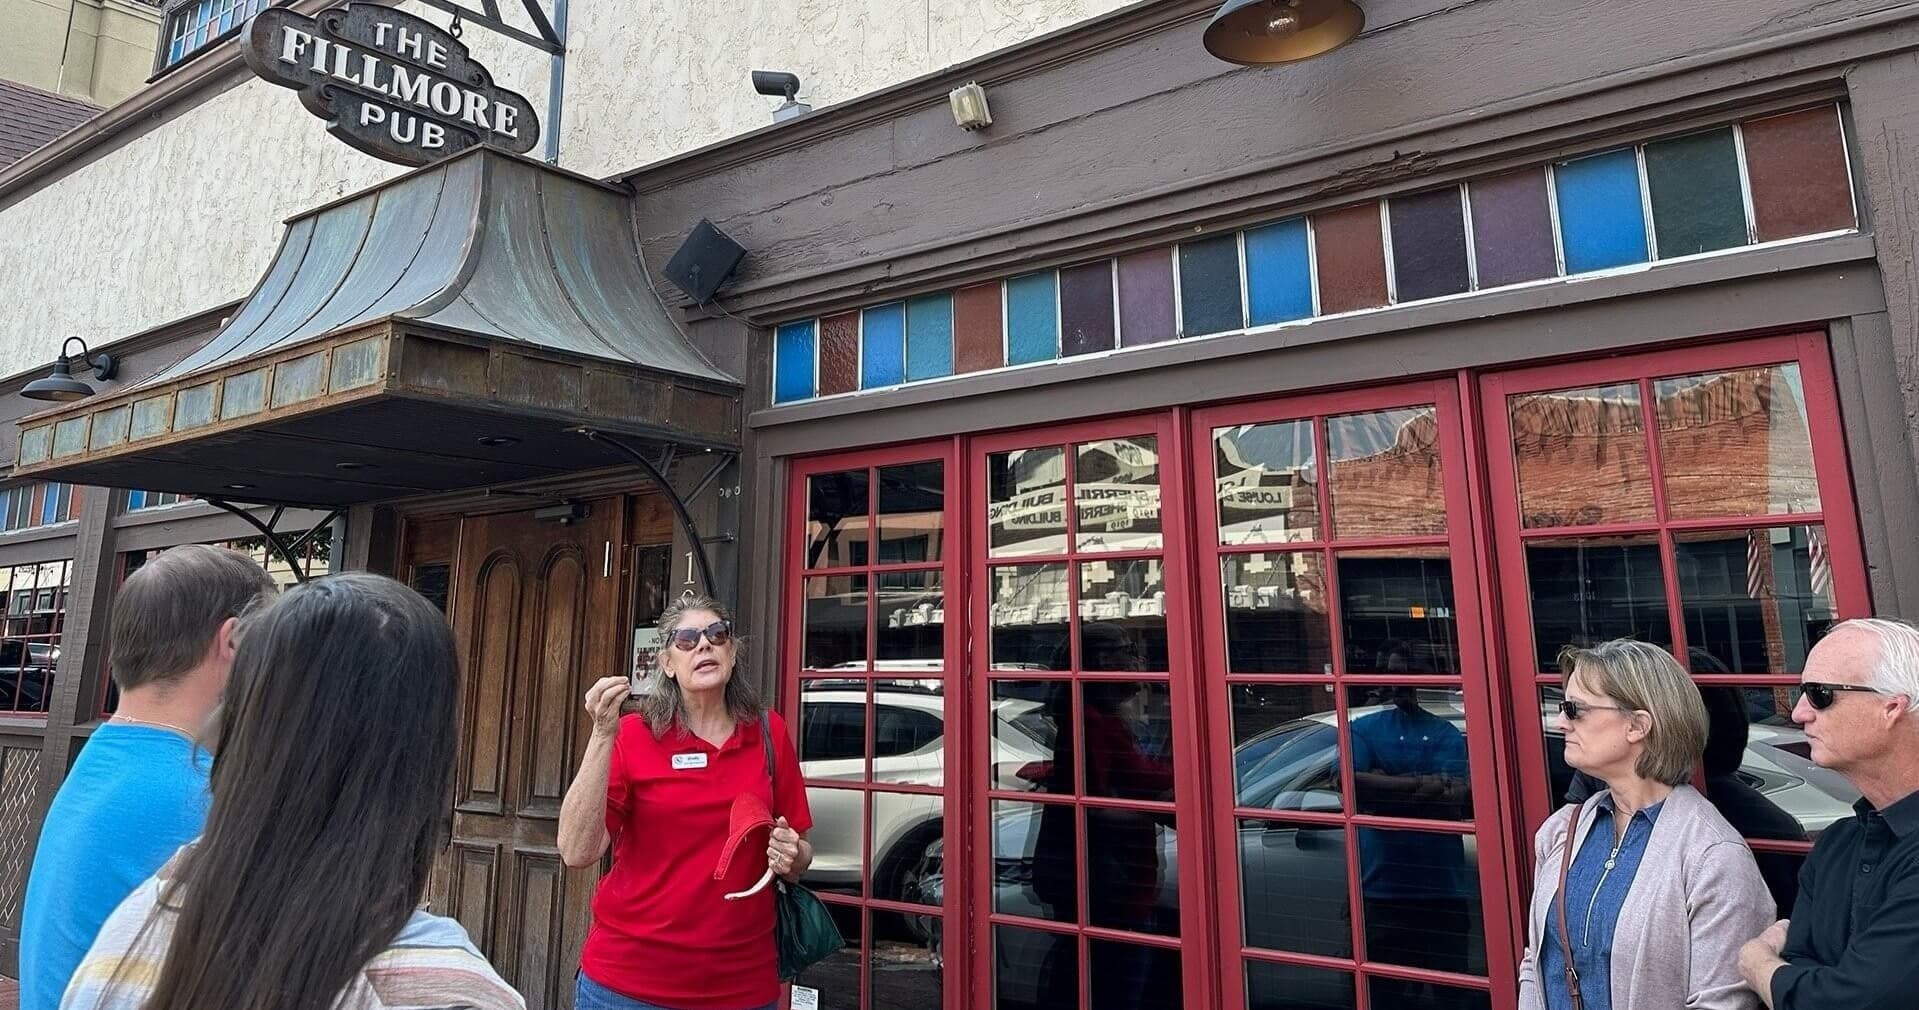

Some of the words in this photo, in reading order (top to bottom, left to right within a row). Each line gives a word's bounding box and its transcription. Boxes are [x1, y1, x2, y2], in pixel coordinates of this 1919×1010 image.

[374, 22, 448, 69] THE
[279, 25, 518, 139] FILLMORE
[360, 102, 445, 149] PUB
